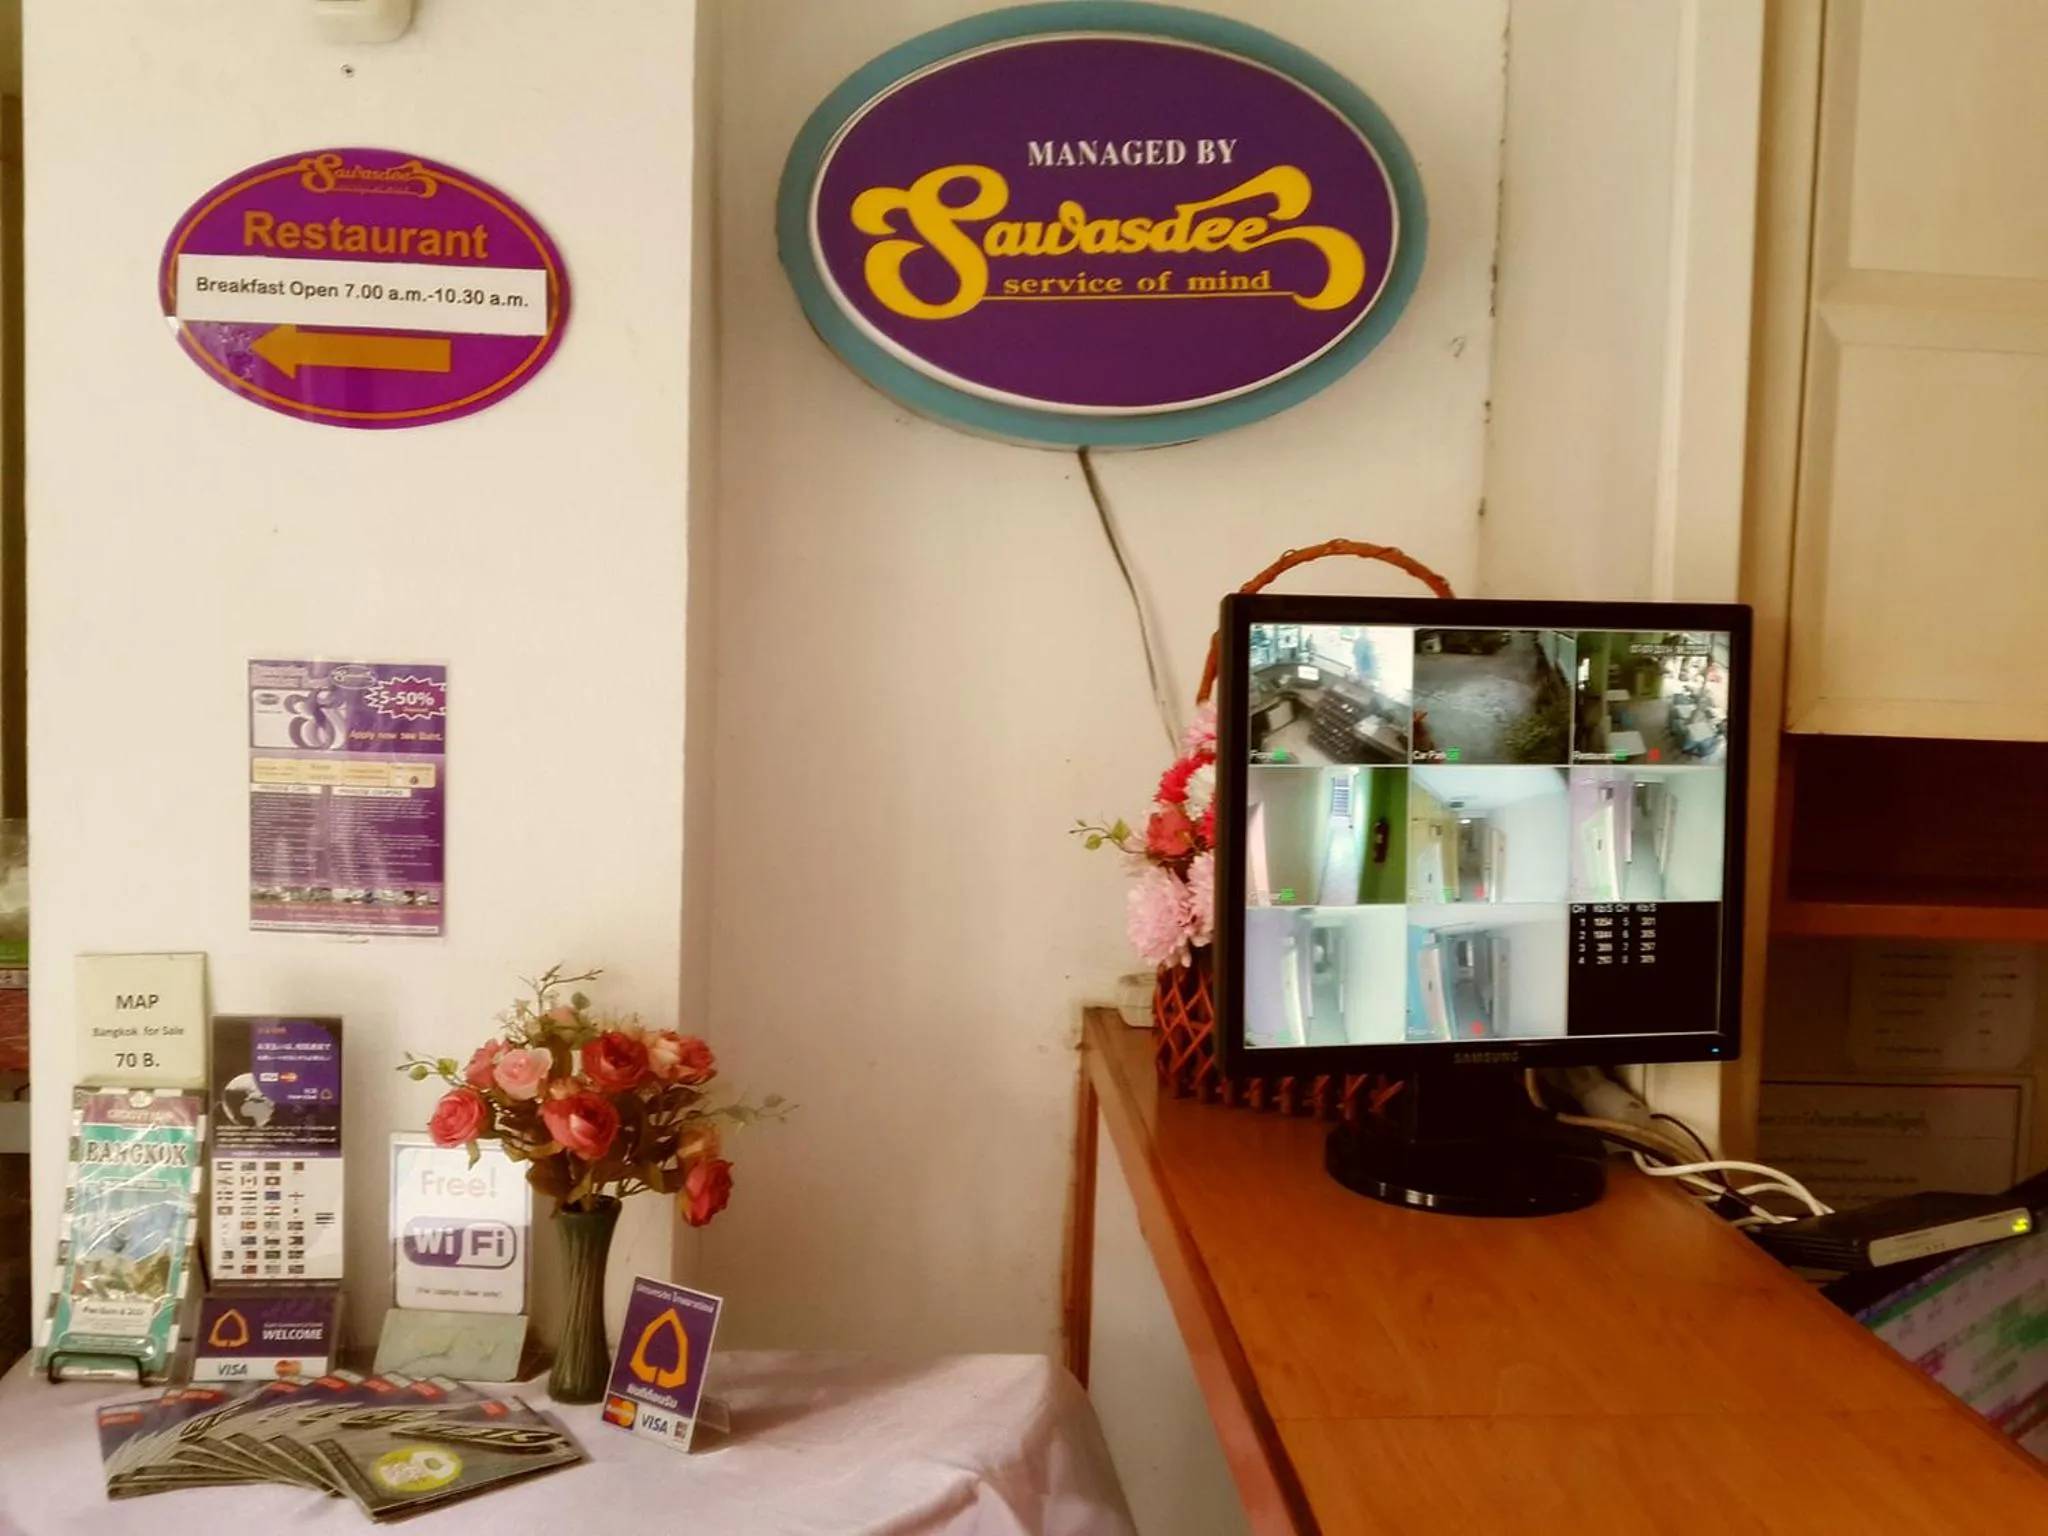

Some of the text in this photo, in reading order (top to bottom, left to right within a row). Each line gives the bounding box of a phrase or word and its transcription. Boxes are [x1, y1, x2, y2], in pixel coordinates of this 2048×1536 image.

[1027, 138, 1238, 167] MANAGED BY
[242, 210, 489, 258] Restaurant
[851, 164, 1366, 320] Sawasdee
[196, 276, 530, 308] Breakfast Open 7.00 a.m.-10.30 a.m.
[1003, 270, 1272, 294] service of mind
[116, 994, 160, 1010] MAP
[115, 1053, 161, 1068] 70 B.
[420, 1168, 496, 1199] Free!
[263, 1329, 323, 1340] WELCOME
[218, 1364, 248, 1376] VISA
[641, 1413, 669, 1434] VISA
